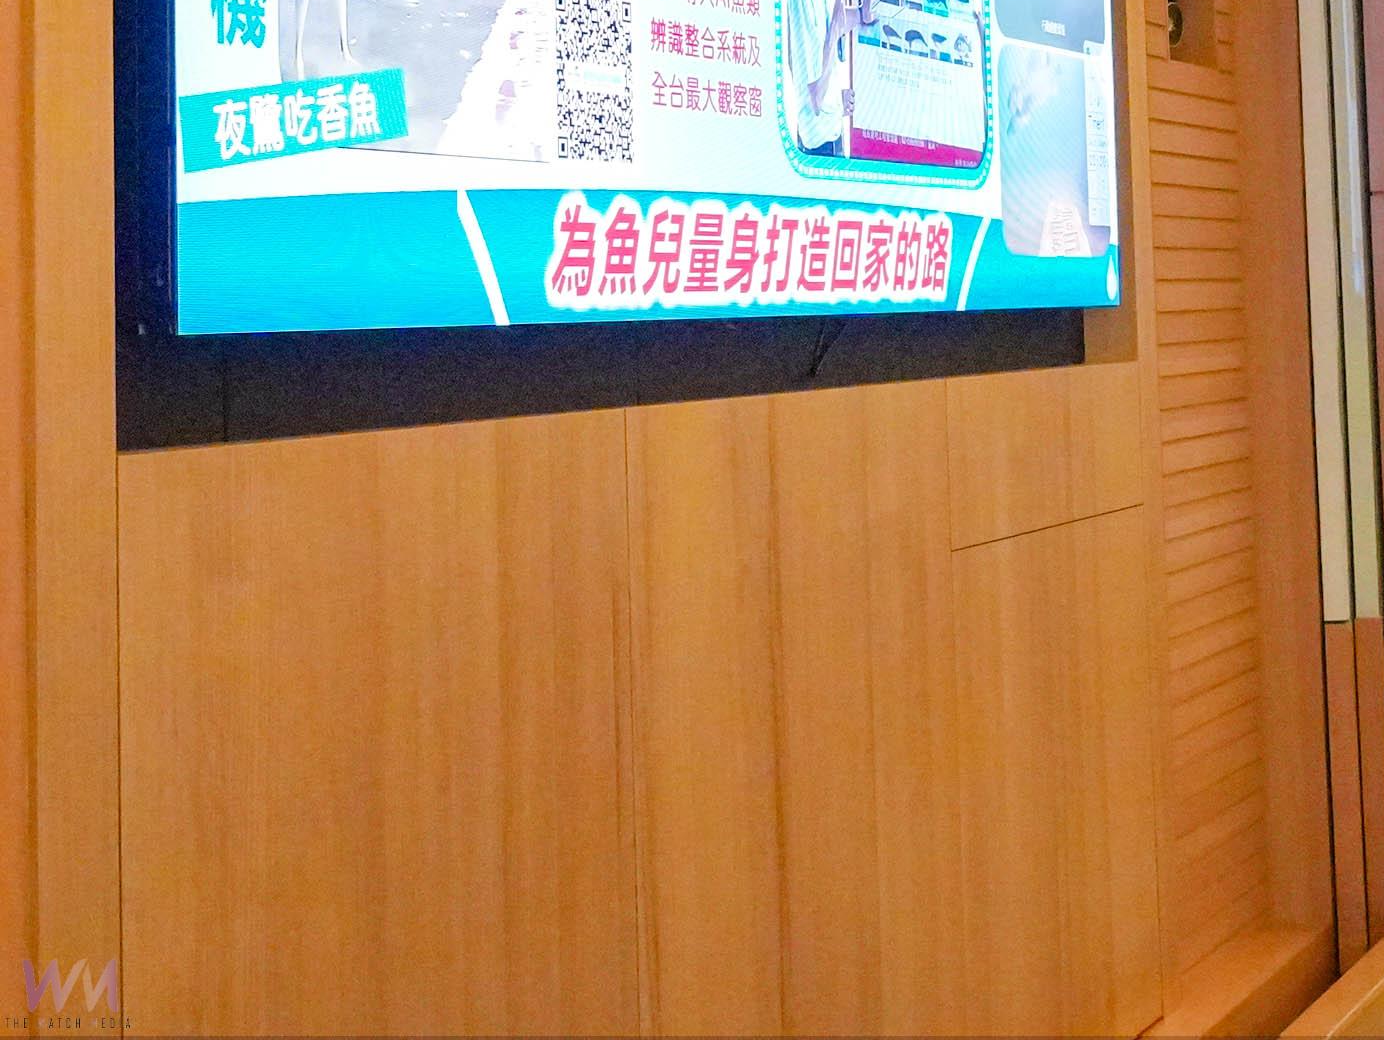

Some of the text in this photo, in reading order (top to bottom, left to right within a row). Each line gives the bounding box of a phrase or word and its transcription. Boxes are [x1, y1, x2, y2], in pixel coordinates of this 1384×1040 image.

[650, 16, 762, 67] 辨識整合系統及
[652, 71, 762, 117] 全台最大觀察窗
[551, 204, 951, 297] 為魚兒量身打造回家的路
